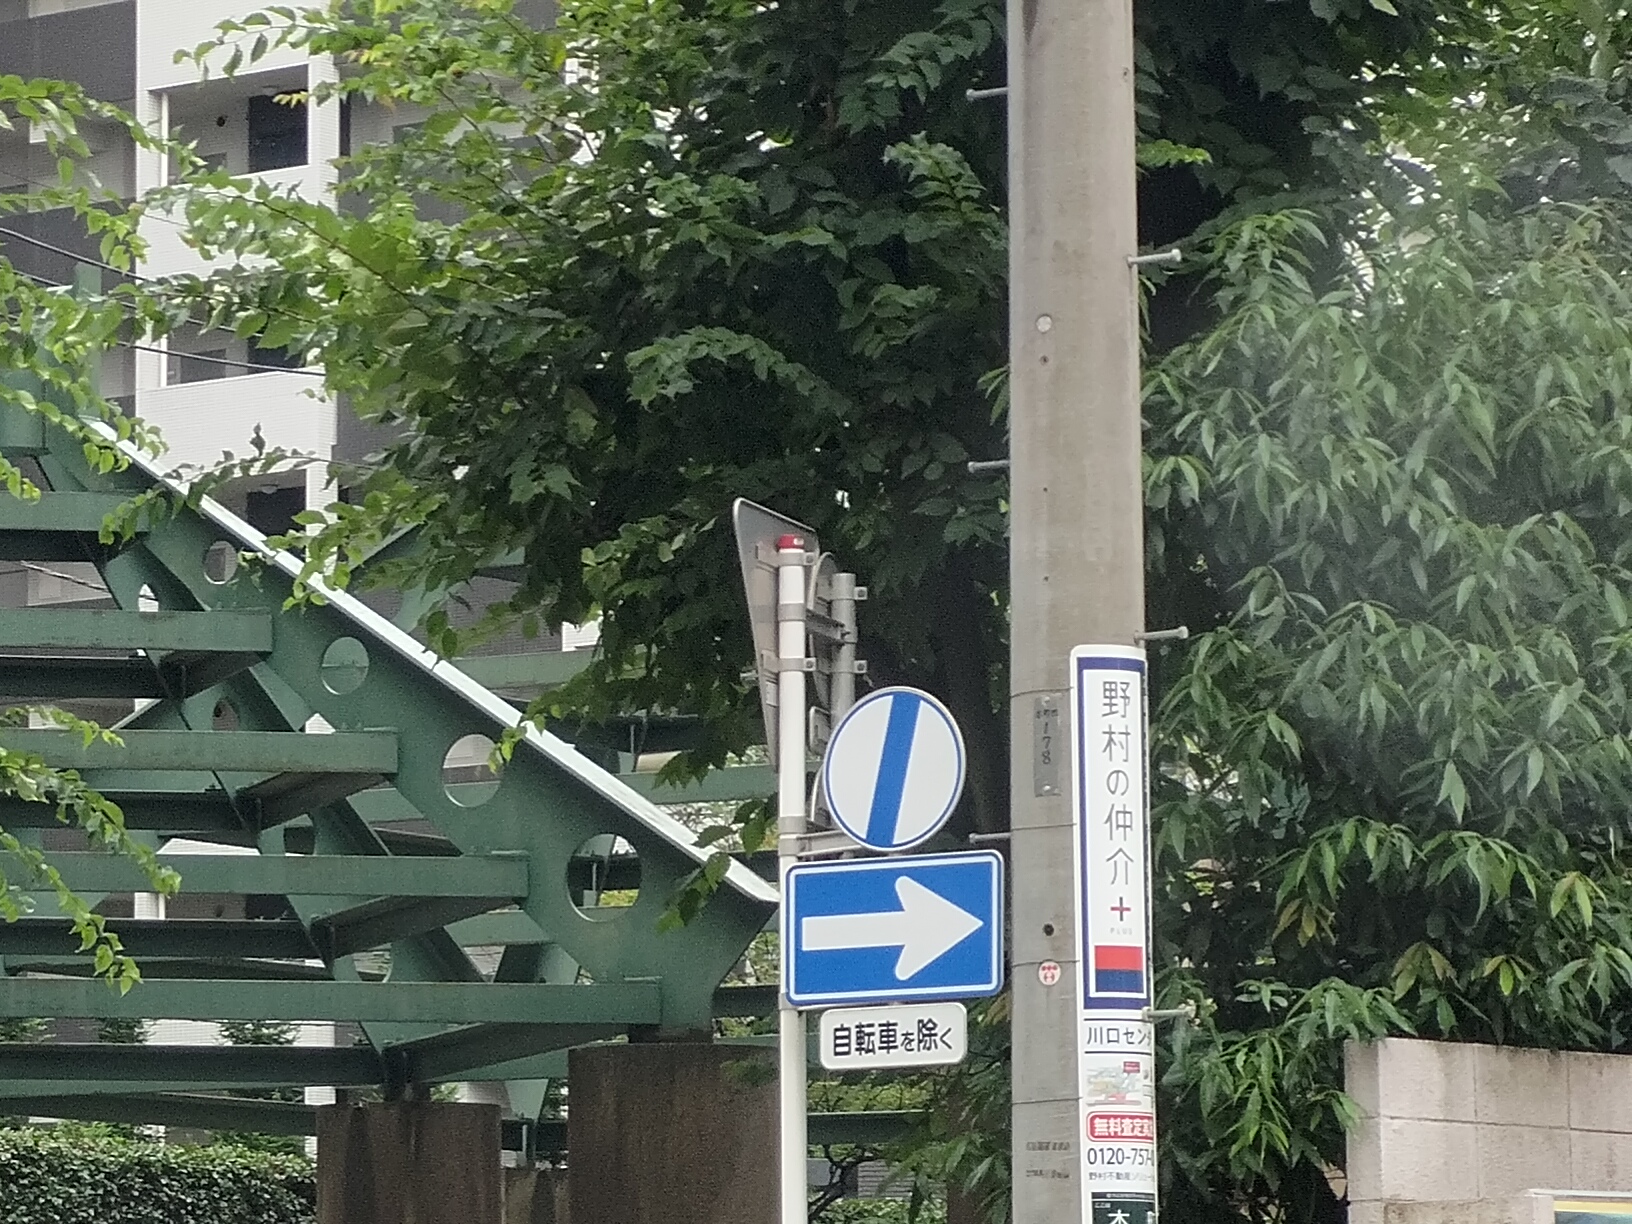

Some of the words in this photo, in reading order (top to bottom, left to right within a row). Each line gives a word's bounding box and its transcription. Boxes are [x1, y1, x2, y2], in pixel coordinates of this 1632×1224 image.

[833, 1018, 952, 1056] 自転車を除く
